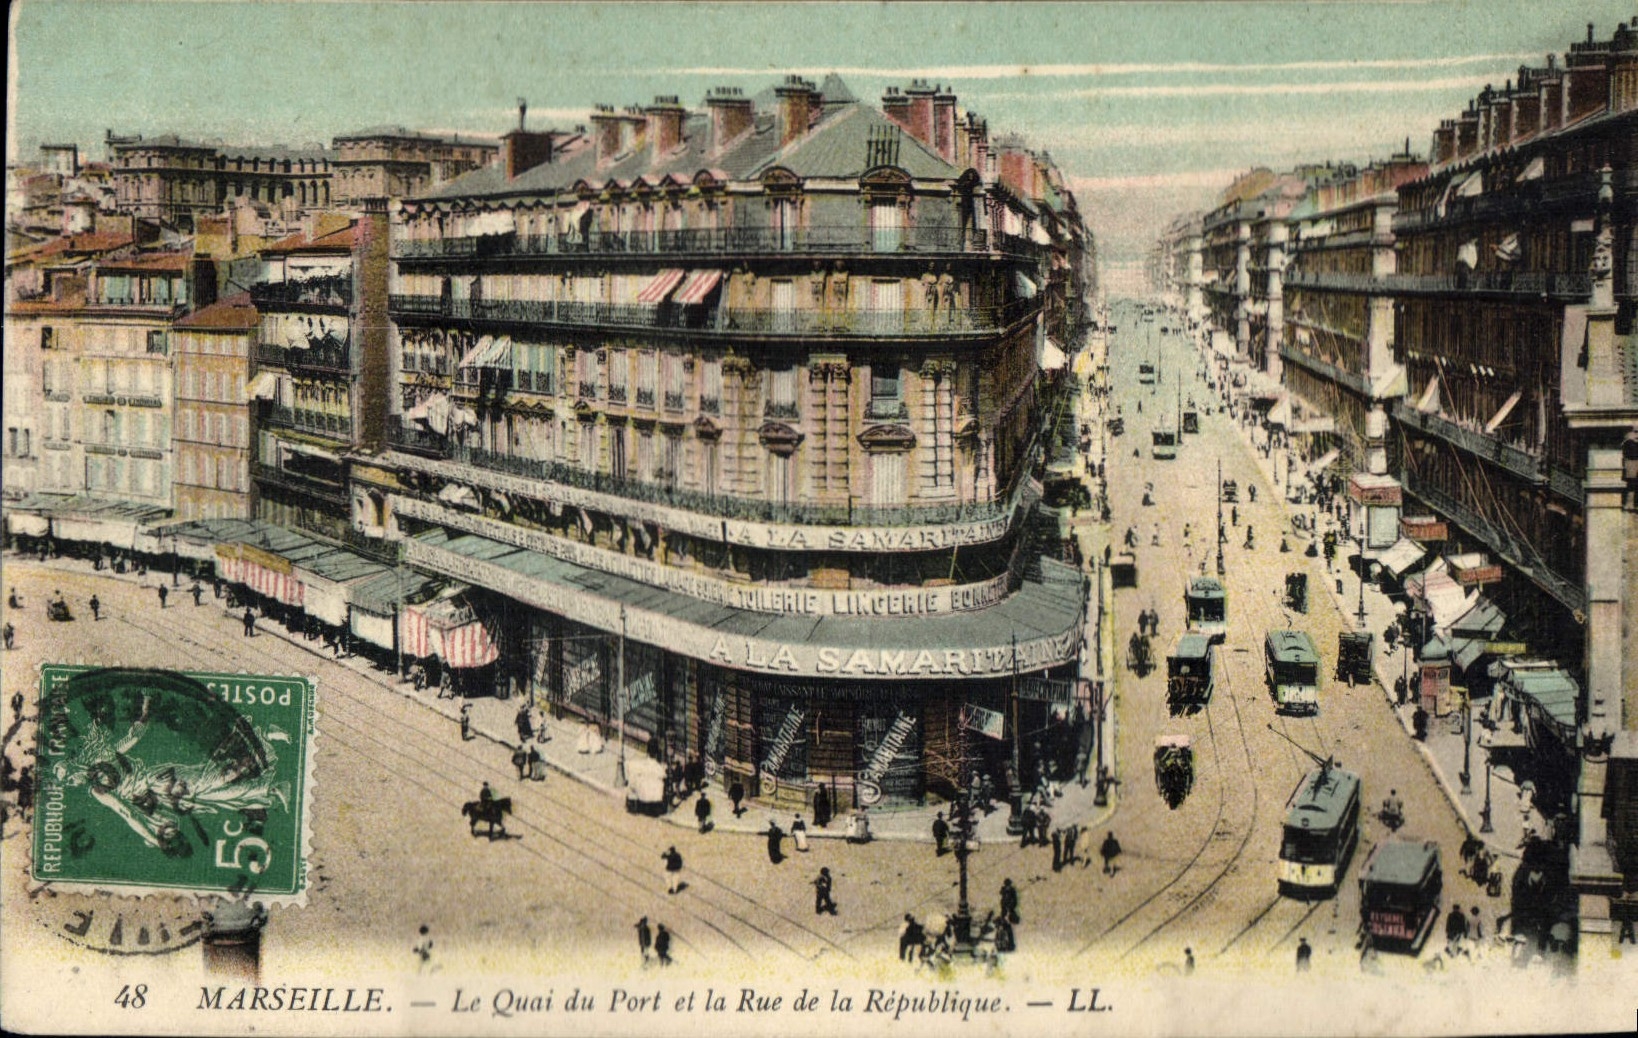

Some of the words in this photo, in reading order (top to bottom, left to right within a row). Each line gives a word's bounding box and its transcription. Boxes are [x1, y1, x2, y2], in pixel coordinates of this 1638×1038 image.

[736, 524, 755, 545] A
[766, 528, 813, 549] LA
[832, 591, 938, 615] LINGERIE
[709, 632, 732, 664] A
[745, 641, 799, 672] LA
[816, 632, 1074, 676] SAMARITAINE
[206, 682, 291, 706] POSTES
